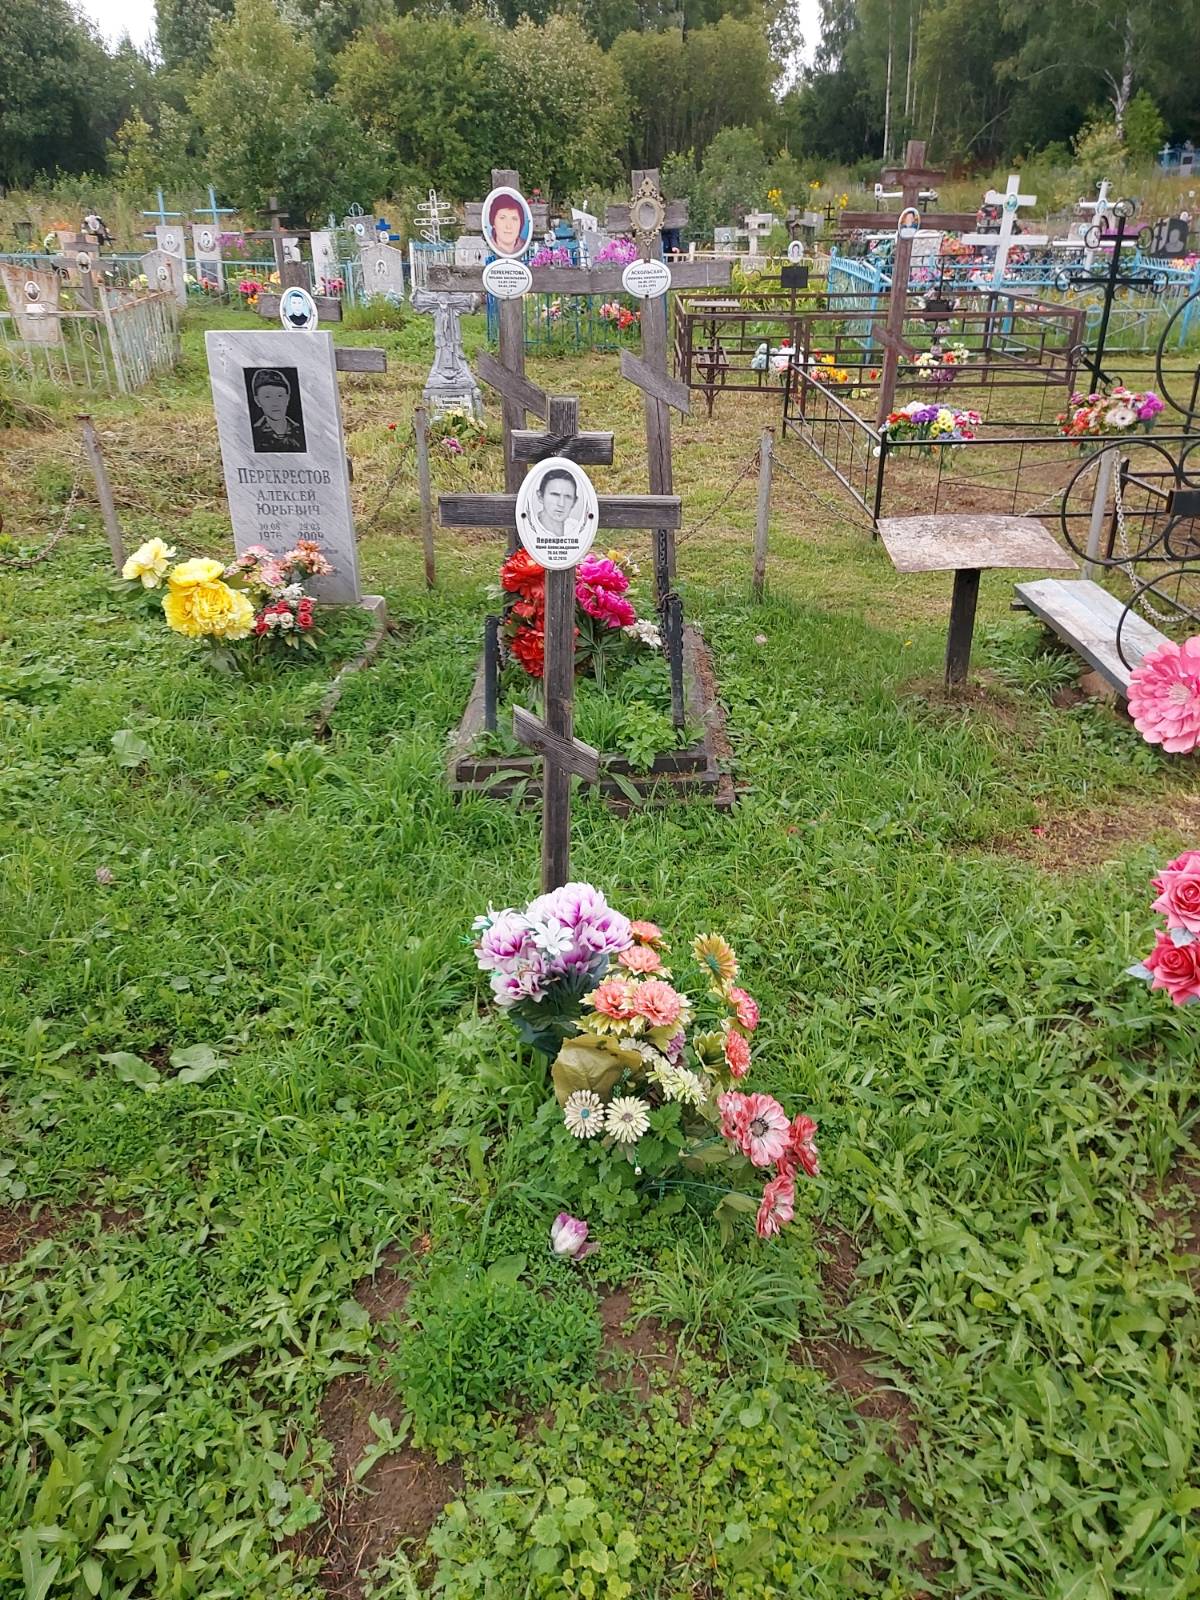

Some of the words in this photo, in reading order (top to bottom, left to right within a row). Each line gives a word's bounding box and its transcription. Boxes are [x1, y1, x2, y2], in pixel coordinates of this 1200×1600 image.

[237, 467, 332, 484] ПЕРЕКРЕСТОВ
[257, 489, 316, 502] АЛЕКСЕЙ
[256, 503, 320, 516] ЮРЬЕВИЧ
[297, 532, 324, 541] 2009
